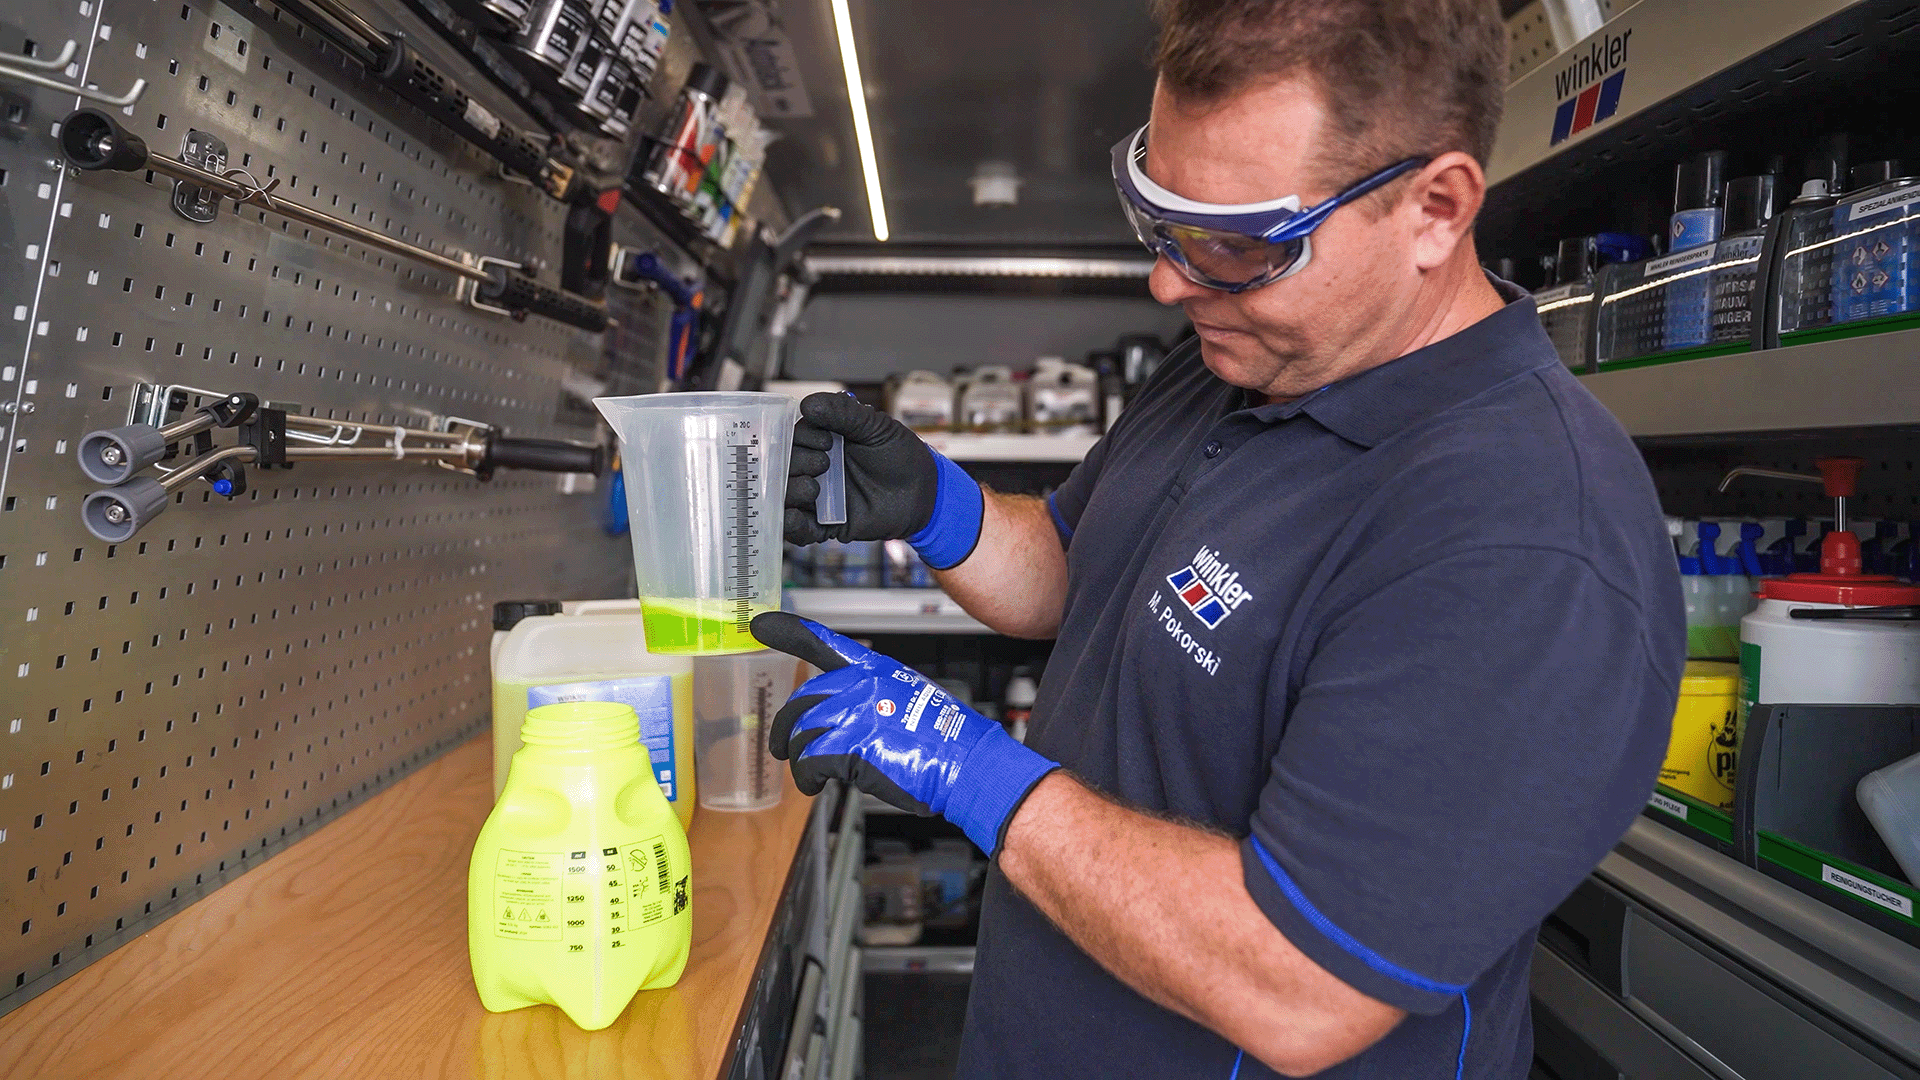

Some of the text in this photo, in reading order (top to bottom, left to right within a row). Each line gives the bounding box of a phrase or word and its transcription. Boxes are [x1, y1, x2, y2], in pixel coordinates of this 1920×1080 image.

[1555, 28, 1632, 101] winkler
[1192, 544, 1253, 610] winkler
[1147, 590, 1221, 676] M. Pokorski
[910, 703, 922, 726] NITRIL
[612, 940, 620, 948] 25
